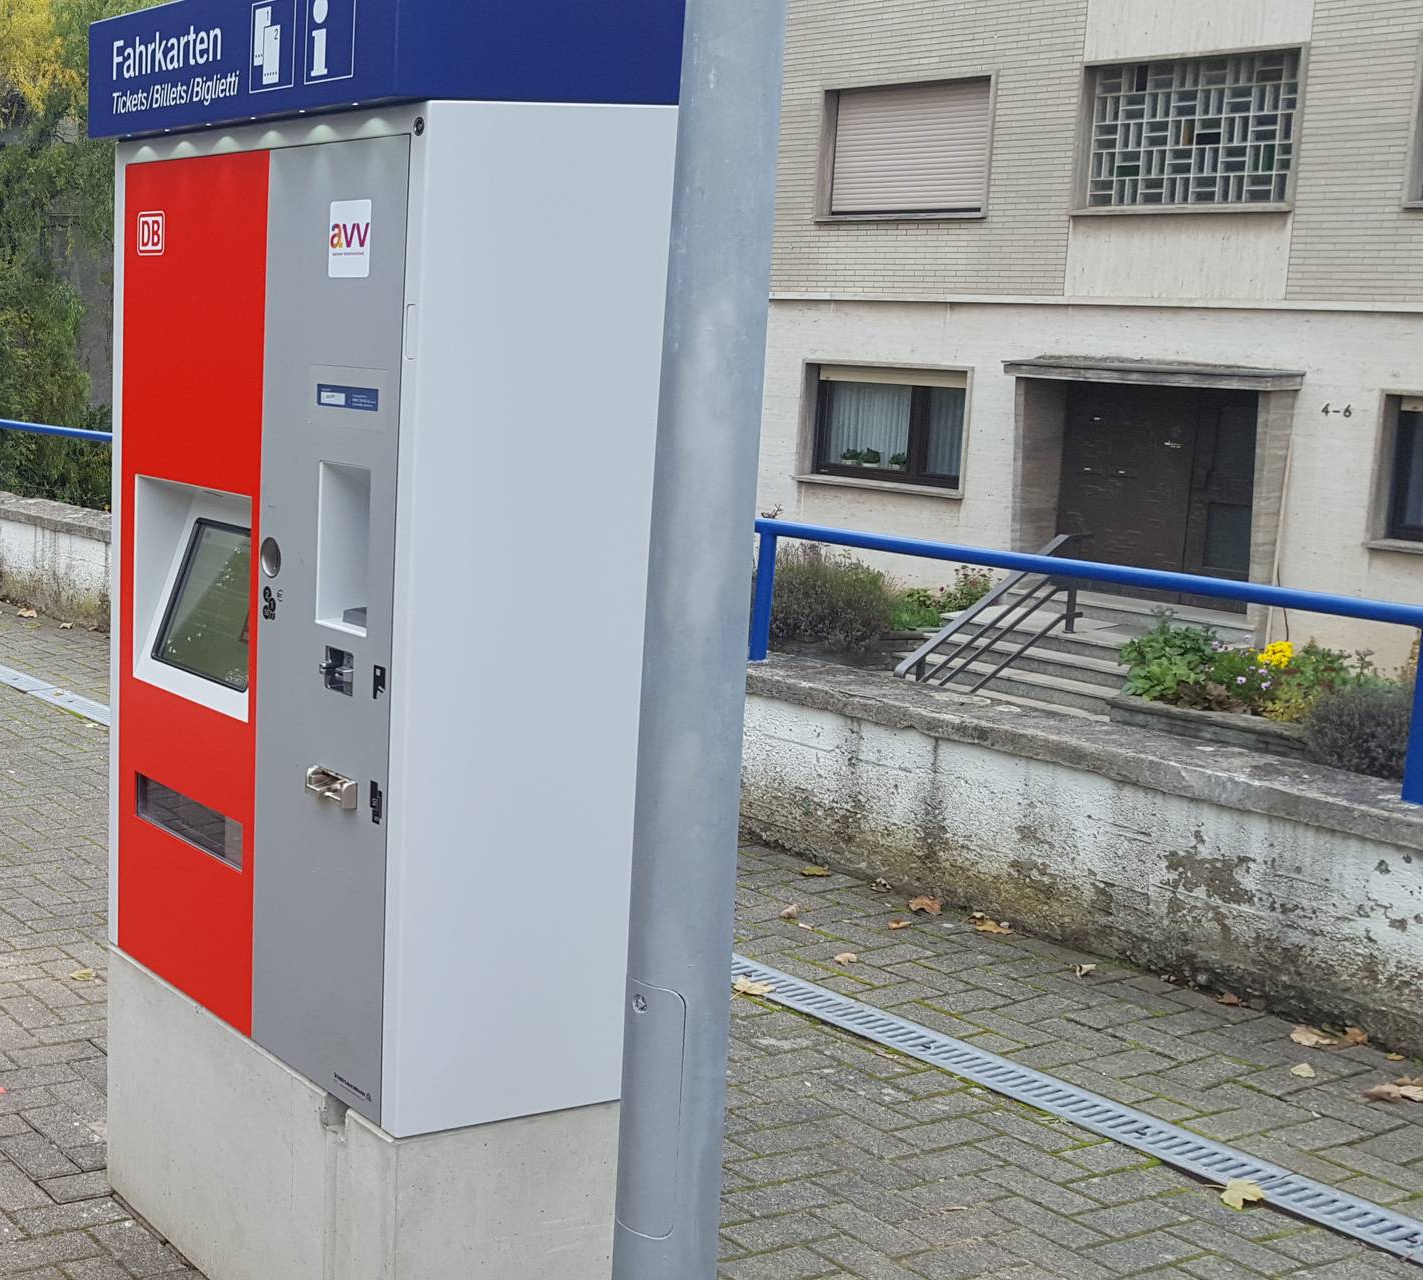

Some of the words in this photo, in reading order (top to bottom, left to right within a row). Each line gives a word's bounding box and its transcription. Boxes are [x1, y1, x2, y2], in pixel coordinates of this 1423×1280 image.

[112, 25, 222, 80] Fahrkarten
[140, 219, 162, 248] DB
[330, 222, 370, 249] avv
[1320, 402, 1353, 418] 4-6
